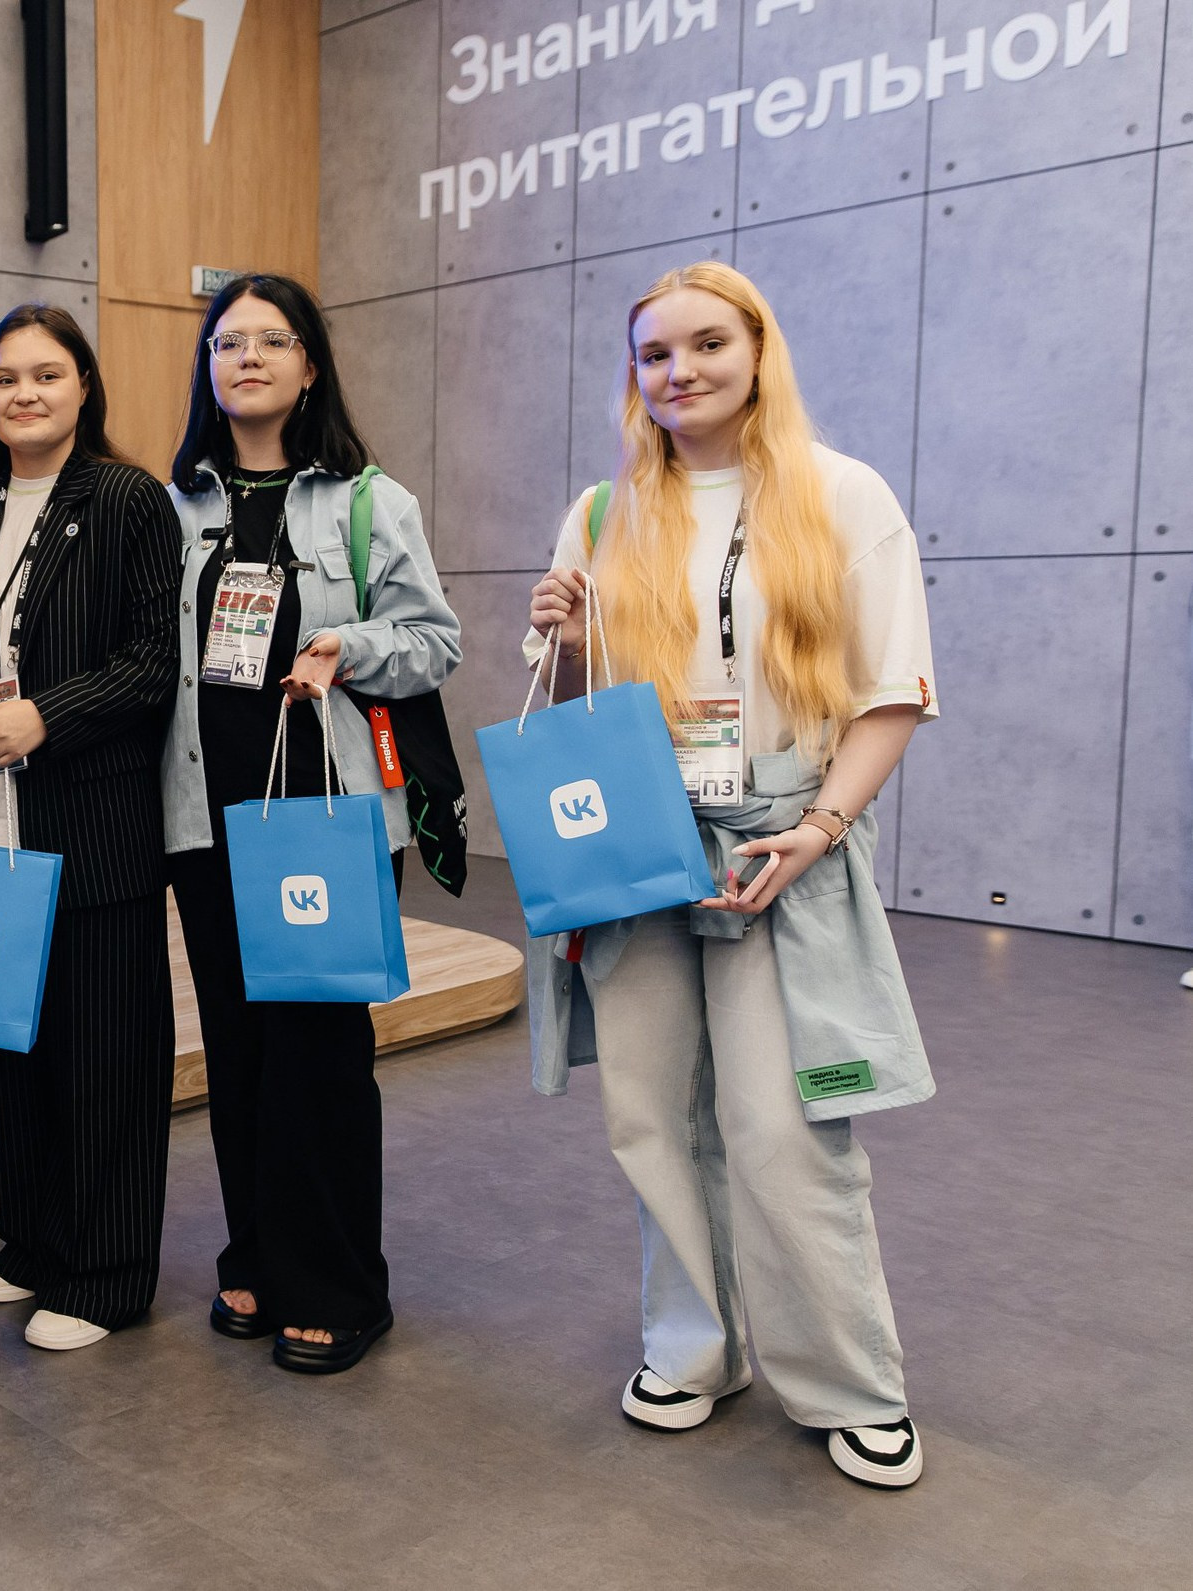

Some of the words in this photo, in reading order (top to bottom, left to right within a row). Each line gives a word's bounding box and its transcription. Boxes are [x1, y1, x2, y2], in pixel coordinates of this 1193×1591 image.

[447, 0, 721, 104] Знания
[19, 560, 33, 599] РОССИЯ
[721, 555, 737, 597] РОССИЯ
[379, 730, 395, 771] Первые
[559, 794, 598, 821] VK
[702, 779, 735, 797] П3
[288, 889, 321, 911] VK
